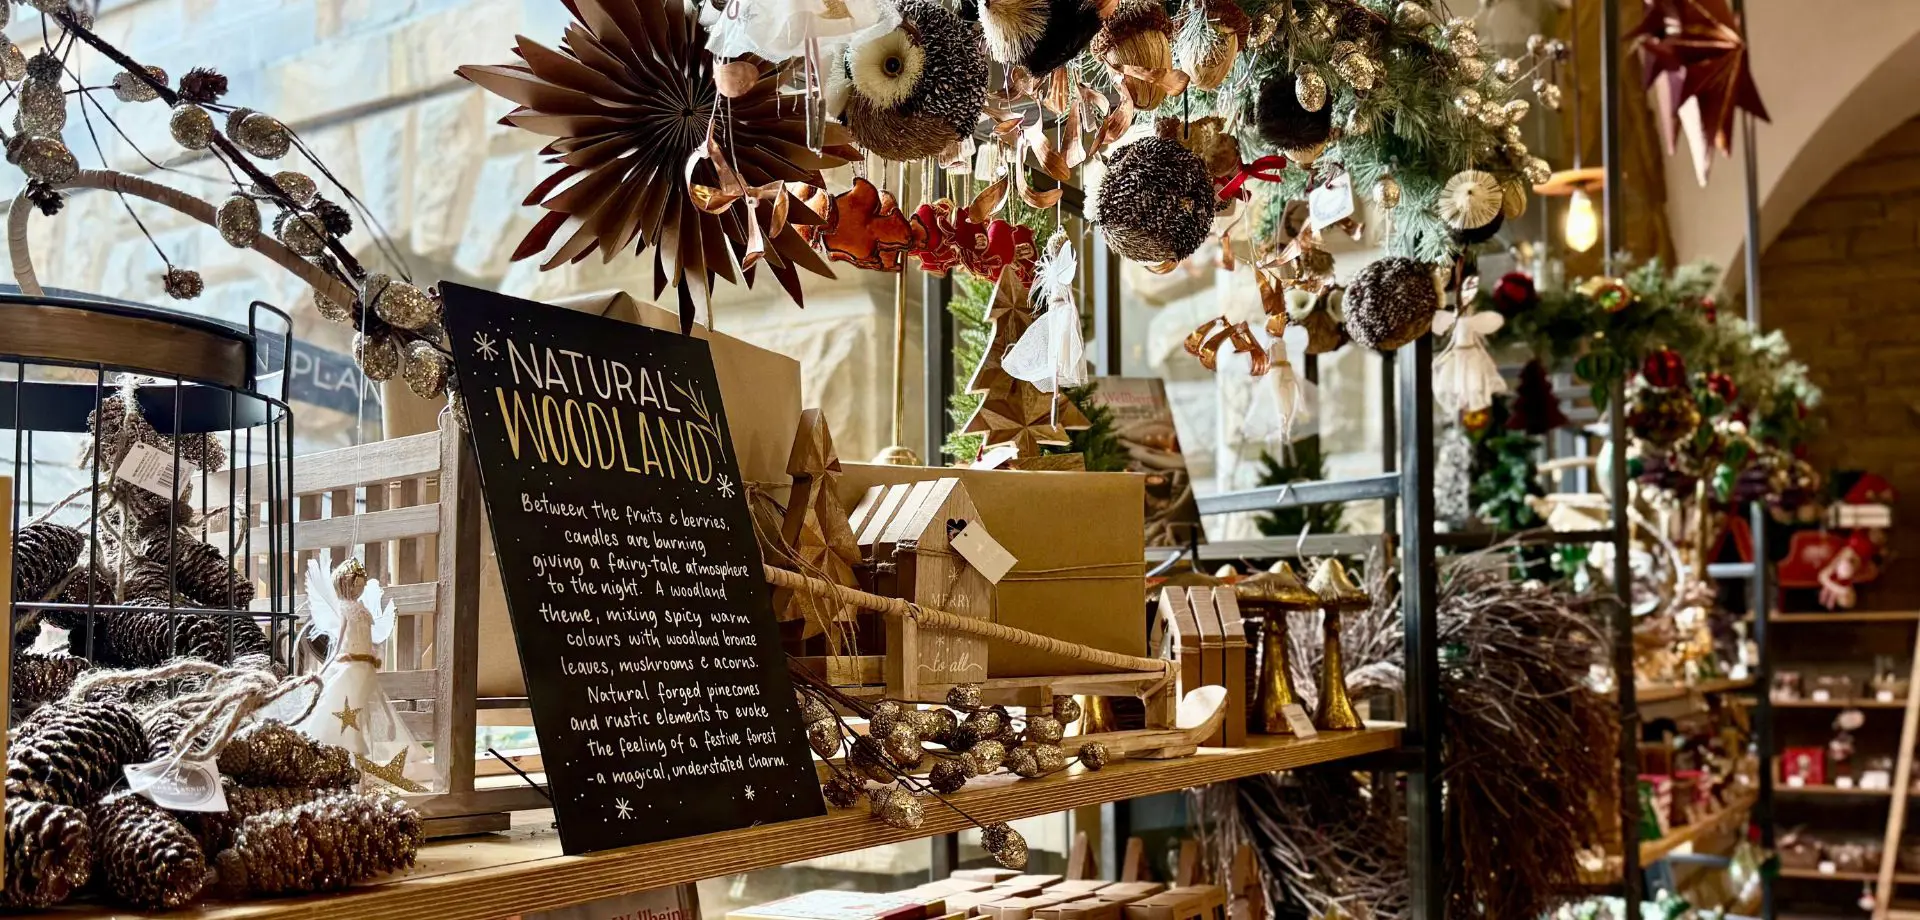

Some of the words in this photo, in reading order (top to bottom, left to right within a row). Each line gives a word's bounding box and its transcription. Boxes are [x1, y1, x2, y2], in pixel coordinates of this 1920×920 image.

[507, 338, 681, 413] NATURAL
[495, 386, 712, 484] WOODLAND
[521, 492, 588, 520] Between
[591, 500, 620, 522] the
[626, 505, 663, 525] fruits
[681, 508, 730, 532] berries,
[564, 528, 619, 547] candles
[627, 532, 650, 549] are
[653, 530, 706, 557] burning
[532, 553, 584, 577] giving
[590, 557, 600, 570] a
[608, 552, 680, 578] fairy-tale
[685, 557, 749, 582] atmosphere
[547, 573, 565, 594] to
[570, 576, 597, 595] the
[600, 578, 643, 601] night.
[655, 580, 665, 597] A
[670, 580, 728, 601] woodland
[538, 602, 600, 625] theme,
[606, 607, 658, 628] mixing
[664, 607, 702, 628] spicy
[710, 611, 751, 624] warm
[566, 628, 621, 647] colours
[628, 629, 661, 648] with
[666, 629, 720, 647] woodland
[722, 629, 758, 646] bronze
[560, 655, 614, 676] leaves,
[619, 655, 694, 674] mushrooms
[714, 655, 759, 669] acorns.
[949, 651, 975, 672] all
[587, 680, 650, 704] Natural
[658, 681, 701, 706] forged
[706, 682, 760, 703] pinecones
[570, 714, 600, 731] and
[605, 706, 650, 728] rustic
[656, 704, 711, 725] elements
[714, 703, 729, 721] to
[735, 702, 769, 718] evoke
[586, 738, 614, 757] the
[619, 735, 668, 759] feeling
[670, 733, 685, 754] of
[689, 736, 698, 749] a
[704, 728, 742, 751] festive
[746, 726, 777, 744] forest
[612, 761, 671, 790] magical,
[672, 755, 744, 778] understated
[748, 753, 789, 769] charm.
